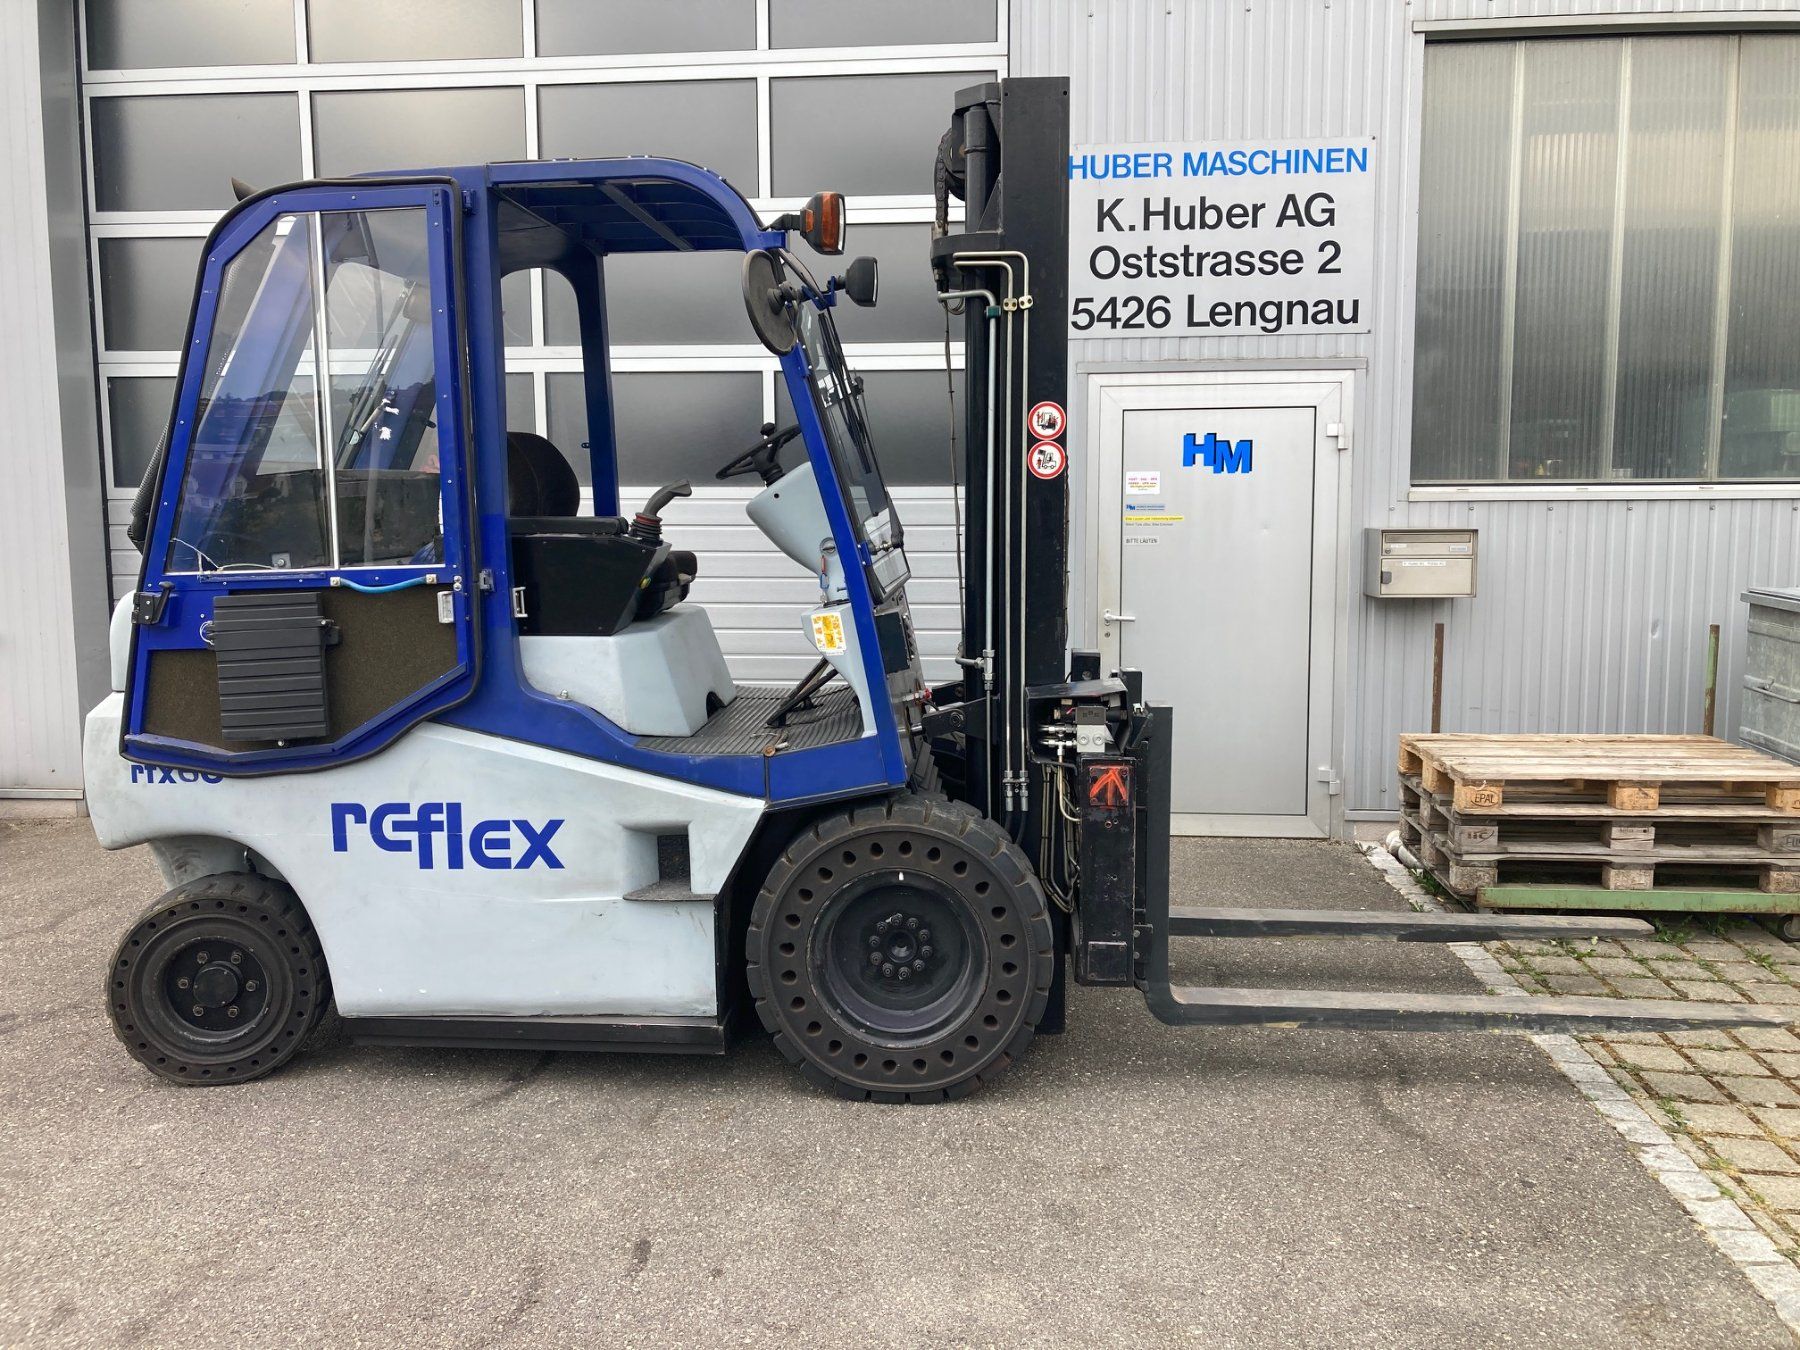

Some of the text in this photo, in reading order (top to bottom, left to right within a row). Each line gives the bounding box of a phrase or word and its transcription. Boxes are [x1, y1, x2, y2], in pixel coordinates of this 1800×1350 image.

[1069, 147, 1368, 180] HUBER MASCHINEN
[1275, 192, 1336, 228] AG
[1089, 240, 1342, 280] Oststrasse 2
[1070, 294, 1360, 333] 5426 Lengnau
[1183, 432, 1253, 474] HM
[1474, 793, 1495, 804] EPAL
